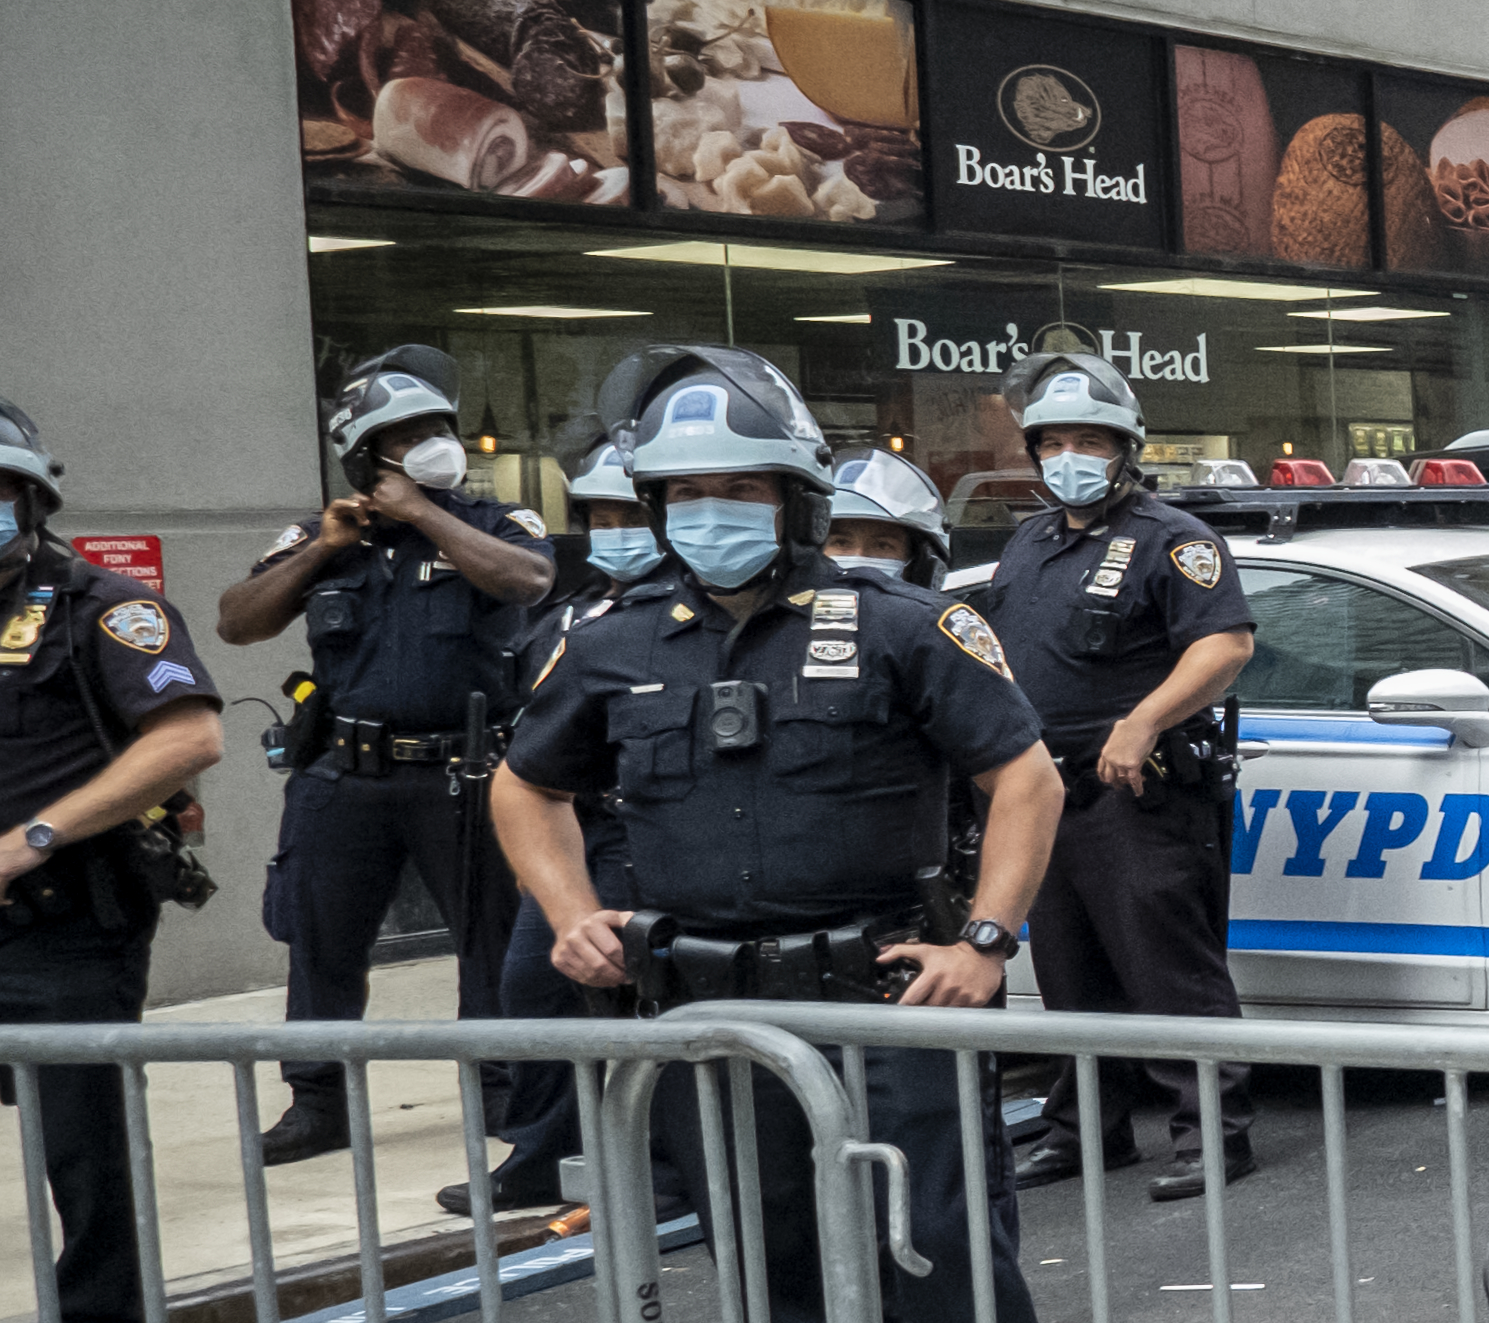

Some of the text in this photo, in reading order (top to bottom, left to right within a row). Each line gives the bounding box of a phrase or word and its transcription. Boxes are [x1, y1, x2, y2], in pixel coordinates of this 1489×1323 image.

[955, 143, 1148, 205] Boar's Head
[893, 318, 1211, 384] Boar's Head
[84, 540, 150, 552] ADDITIONAL
[103, 553, 132, 565] FDNY
